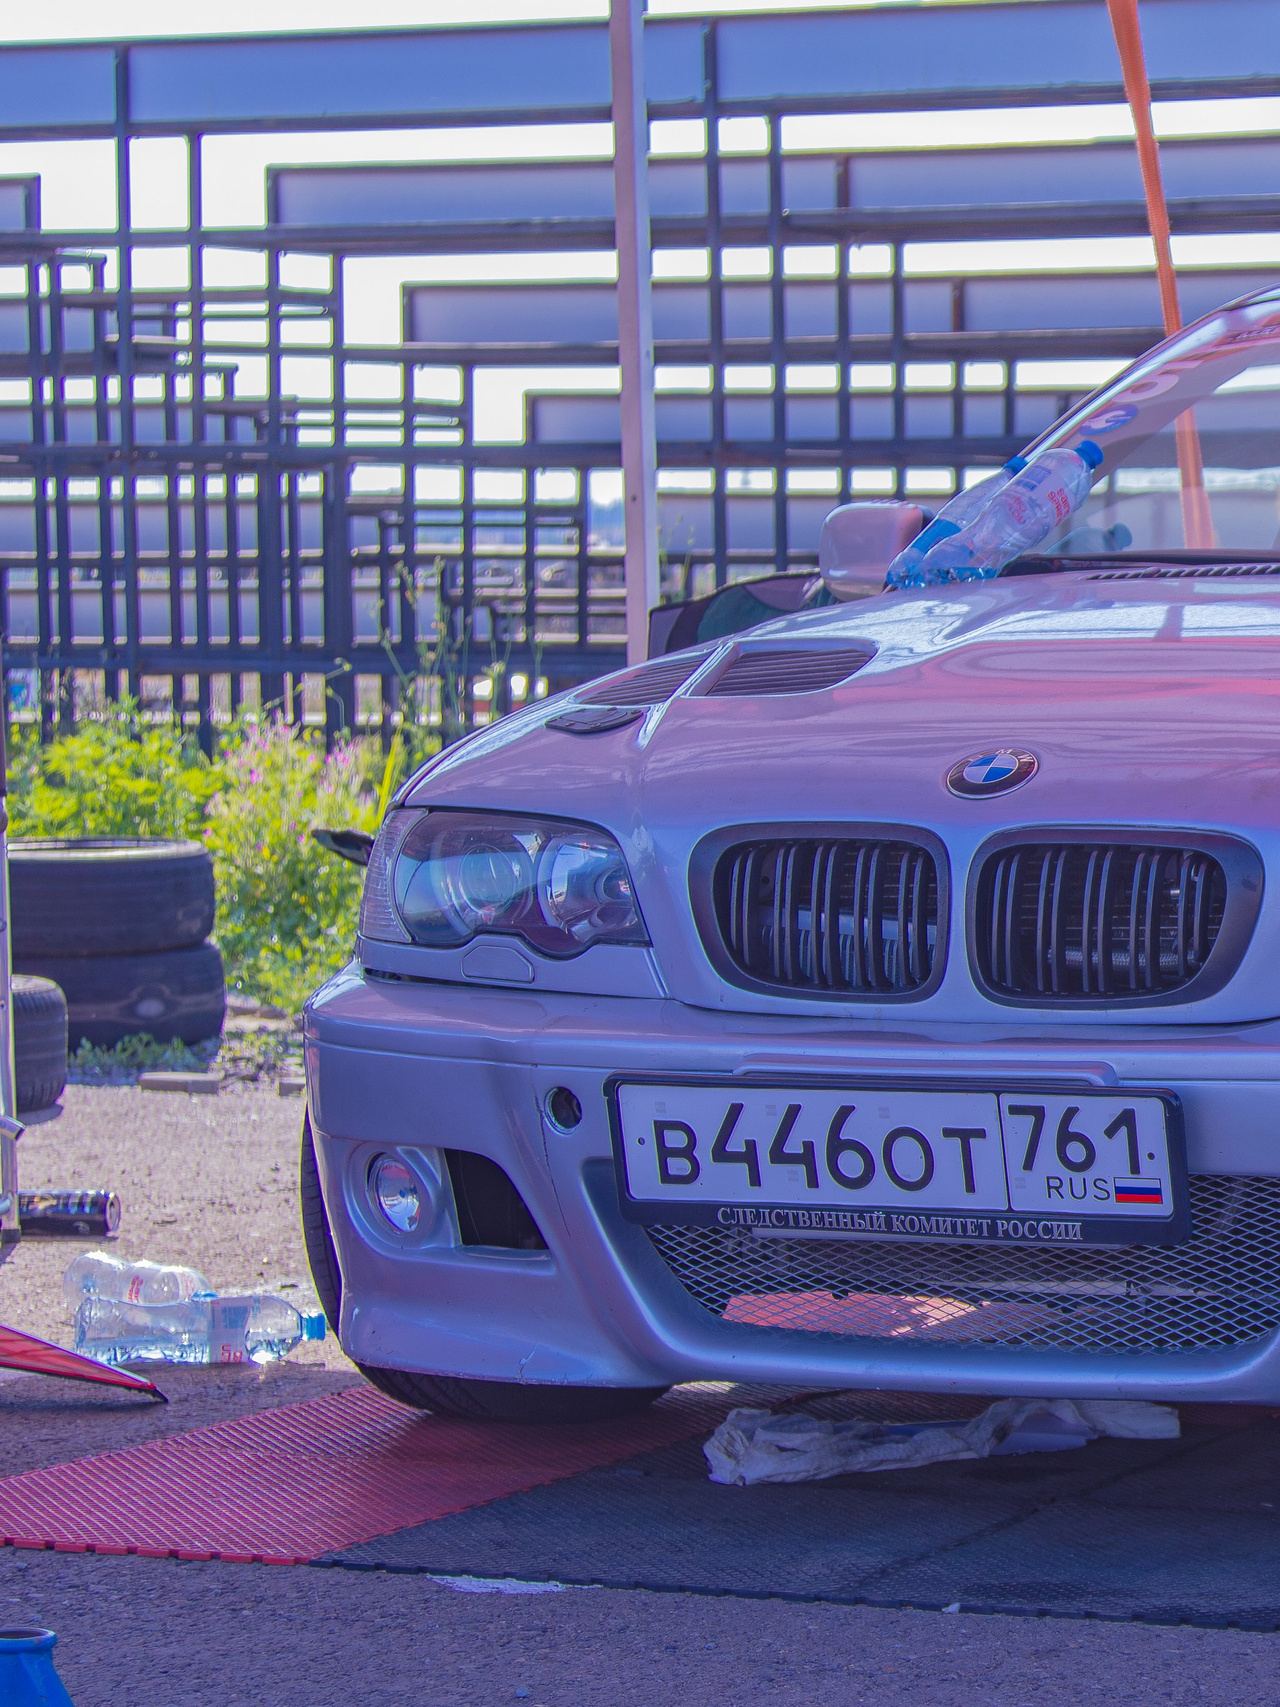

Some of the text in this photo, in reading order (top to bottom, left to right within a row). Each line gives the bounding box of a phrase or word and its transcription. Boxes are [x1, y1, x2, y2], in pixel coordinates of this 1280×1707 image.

[1008, 1104, 1142, 1175] 761
[1046, 1176, 1110, 1201] RUS
[716, 1206, 1084, 1240] СЛЕДСТВЕННЫЙ КОМИТЕТ РОССИИ
